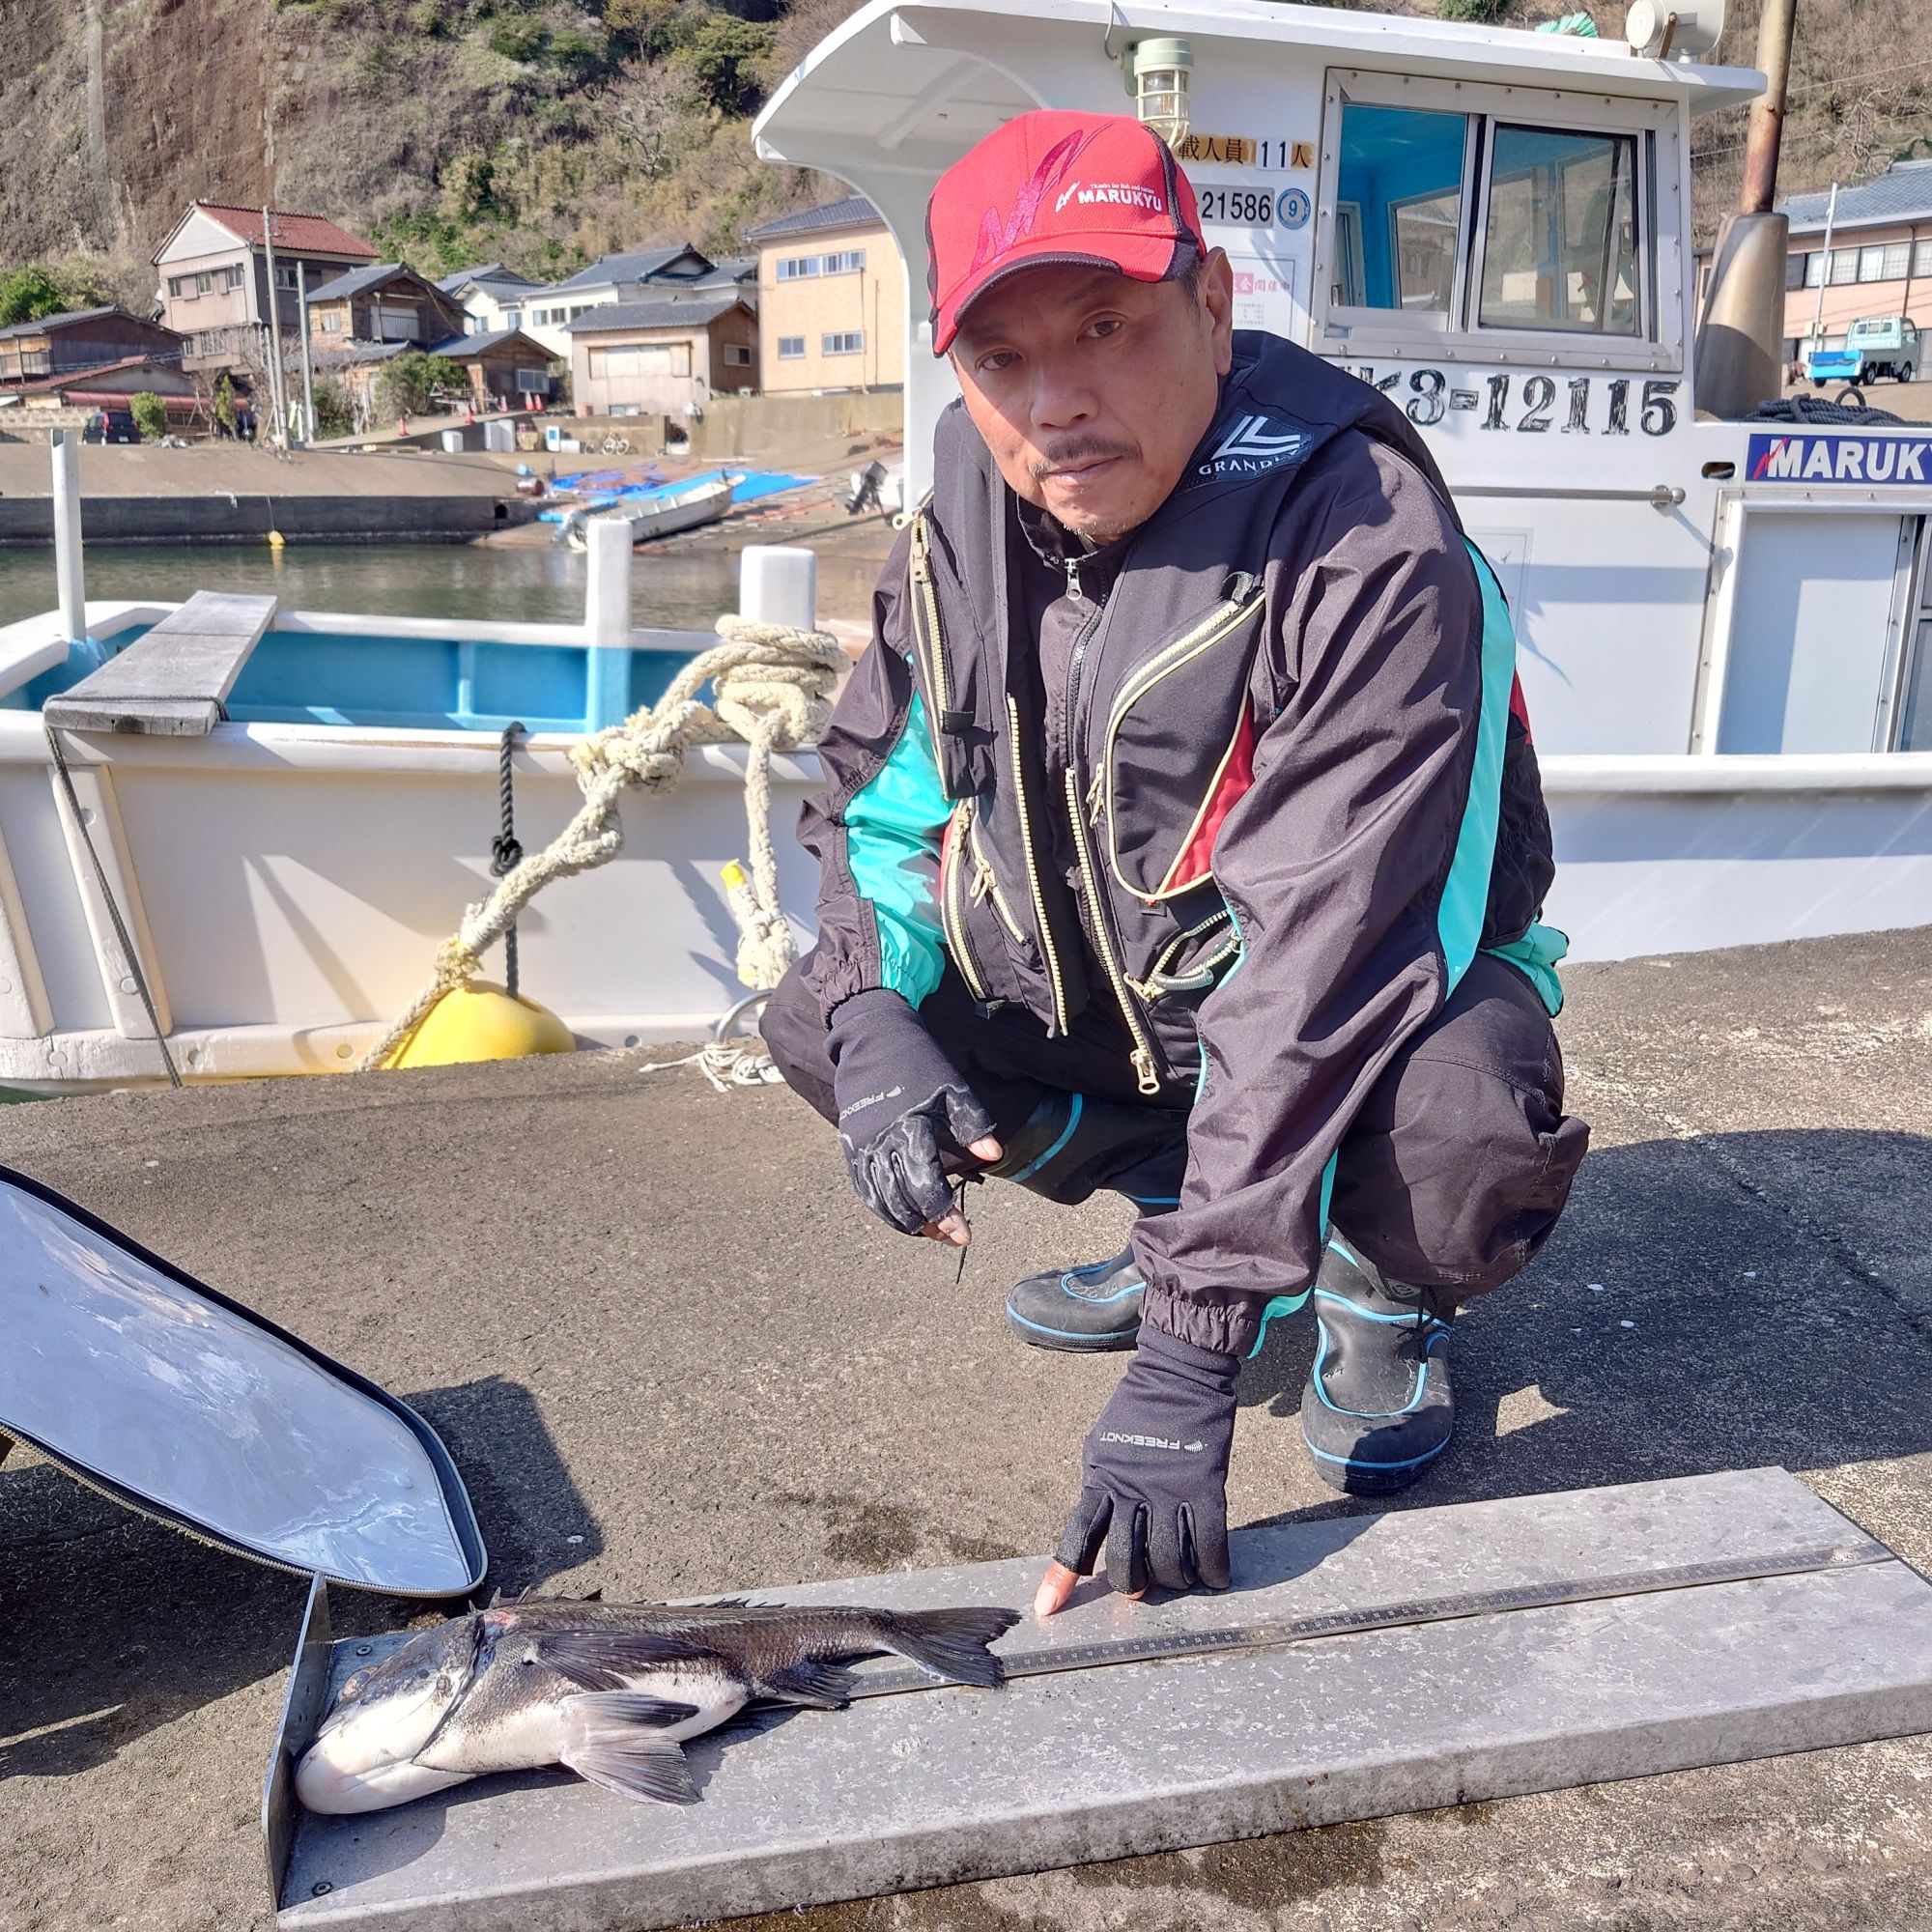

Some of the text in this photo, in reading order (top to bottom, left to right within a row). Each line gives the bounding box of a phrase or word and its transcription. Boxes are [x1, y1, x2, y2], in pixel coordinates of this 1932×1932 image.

[1293, 144, 1309, 168] 人
[1077, 188, 1162, 212] MARUKYU
[1288, 199, 1298, 217] 9
[1767, 439, 1932, 482] MARUK
[1100, 1432, 1180, 1450] FREEKNOT
